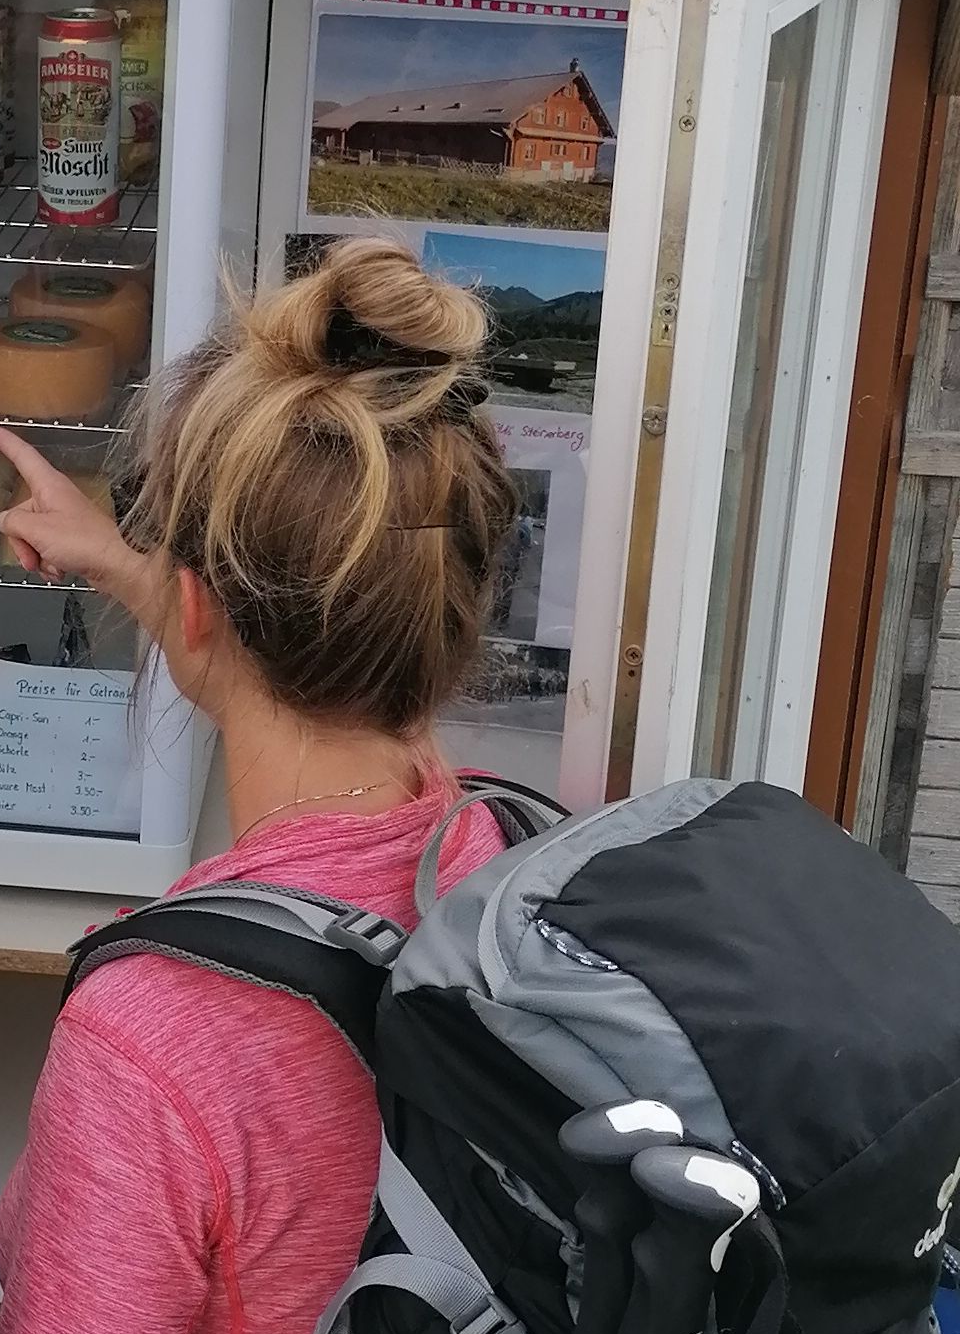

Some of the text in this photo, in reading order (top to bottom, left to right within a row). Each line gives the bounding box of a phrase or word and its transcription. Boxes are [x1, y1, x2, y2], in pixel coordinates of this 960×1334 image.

[41, 63, 109, 79] RAMSEIER
[16, 679, 56, 696] Preise
[64, 682, 81, 697] für
[26, 782, 46, 794] Most
